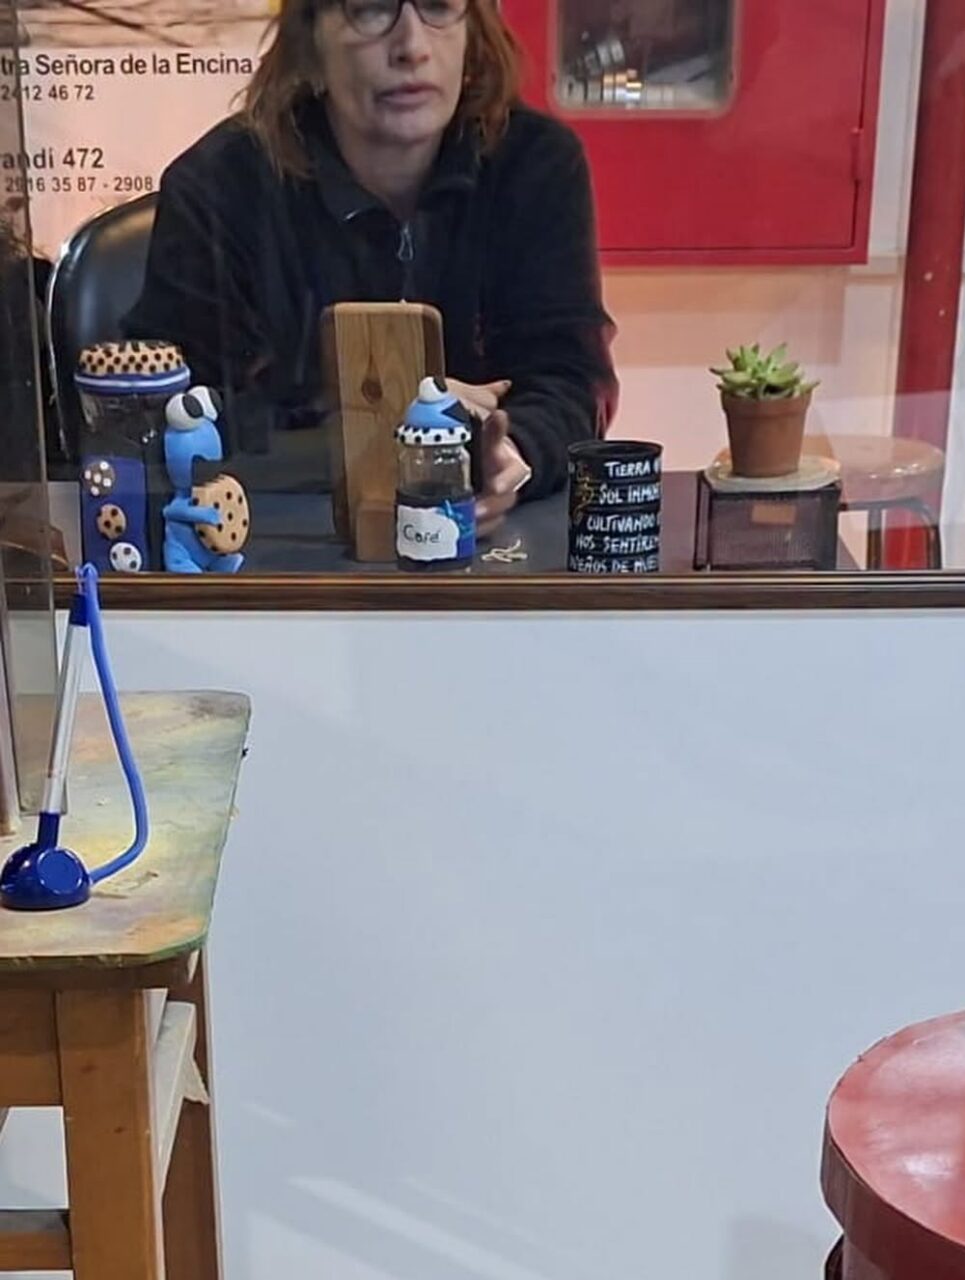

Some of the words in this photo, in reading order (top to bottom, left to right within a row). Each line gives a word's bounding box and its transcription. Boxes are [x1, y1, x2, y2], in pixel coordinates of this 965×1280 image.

[35, 53, 115, 76] Señora
[120, 53, 147, 75] de
[152, 53, 171, 75] la
[176, 52, 253, 75] Encina
[48, 84, 69, 100] 46
[74, 84, 95, 100] 72
[62, 147, 105, 169] 472
[51, 176, 72, 192] 35
[77, 176, 97, 192] 87
[113, 176, 154, 192] 2908
[605, 461, 651, 478] TIERRA
[600, 484, 623, 504] SOL
[403, 523, 442, 544] Café
